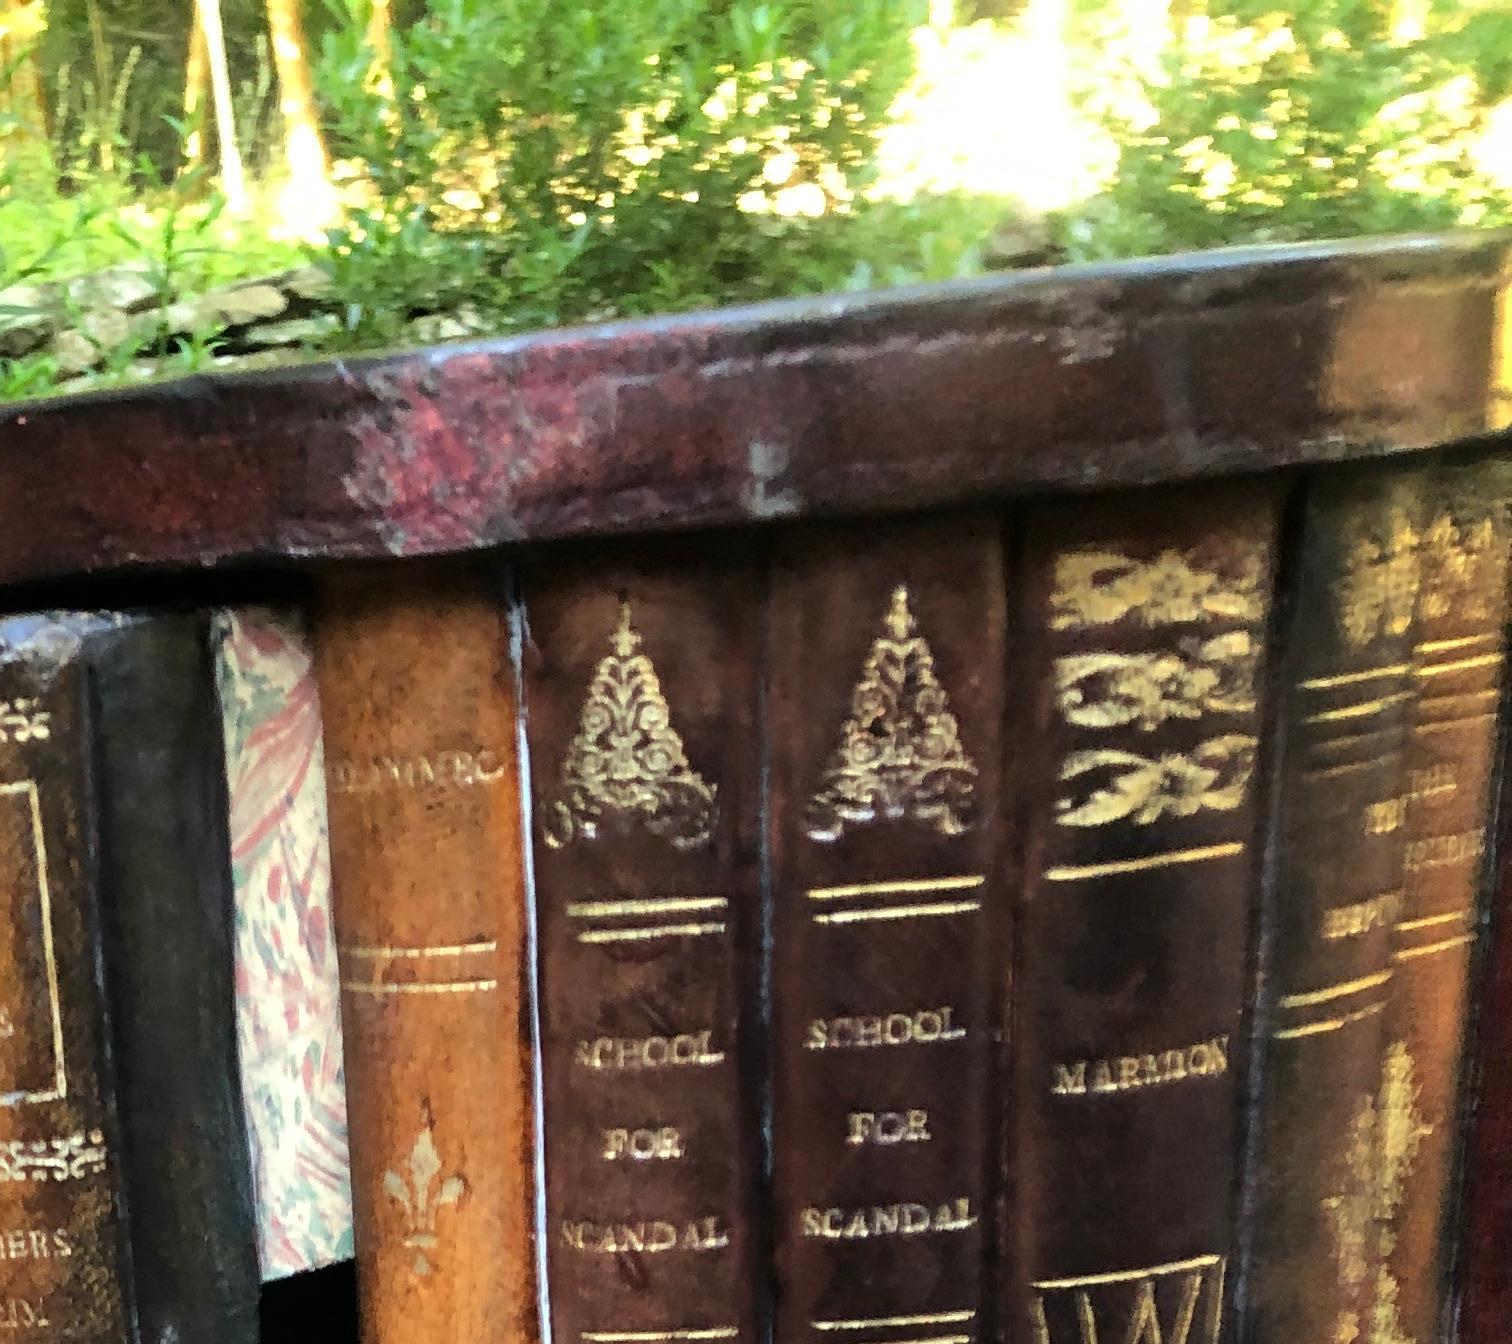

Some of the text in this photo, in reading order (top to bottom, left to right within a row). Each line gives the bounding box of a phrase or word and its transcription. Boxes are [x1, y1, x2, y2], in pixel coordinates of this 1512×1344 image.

[801, 1006, 968, 1050] SCHOOL
[575, 1029, 725, 1070] SCHOOL
[1050, 1033, 1230, 1095] MARMION
[602, 1126, 686, 1161] FOR
[844, 1109, 932, 1146] FOR
[560, 1215, 731, 1253] SCANDAL
[800, 1196, 980, 1239] SCANDAL
